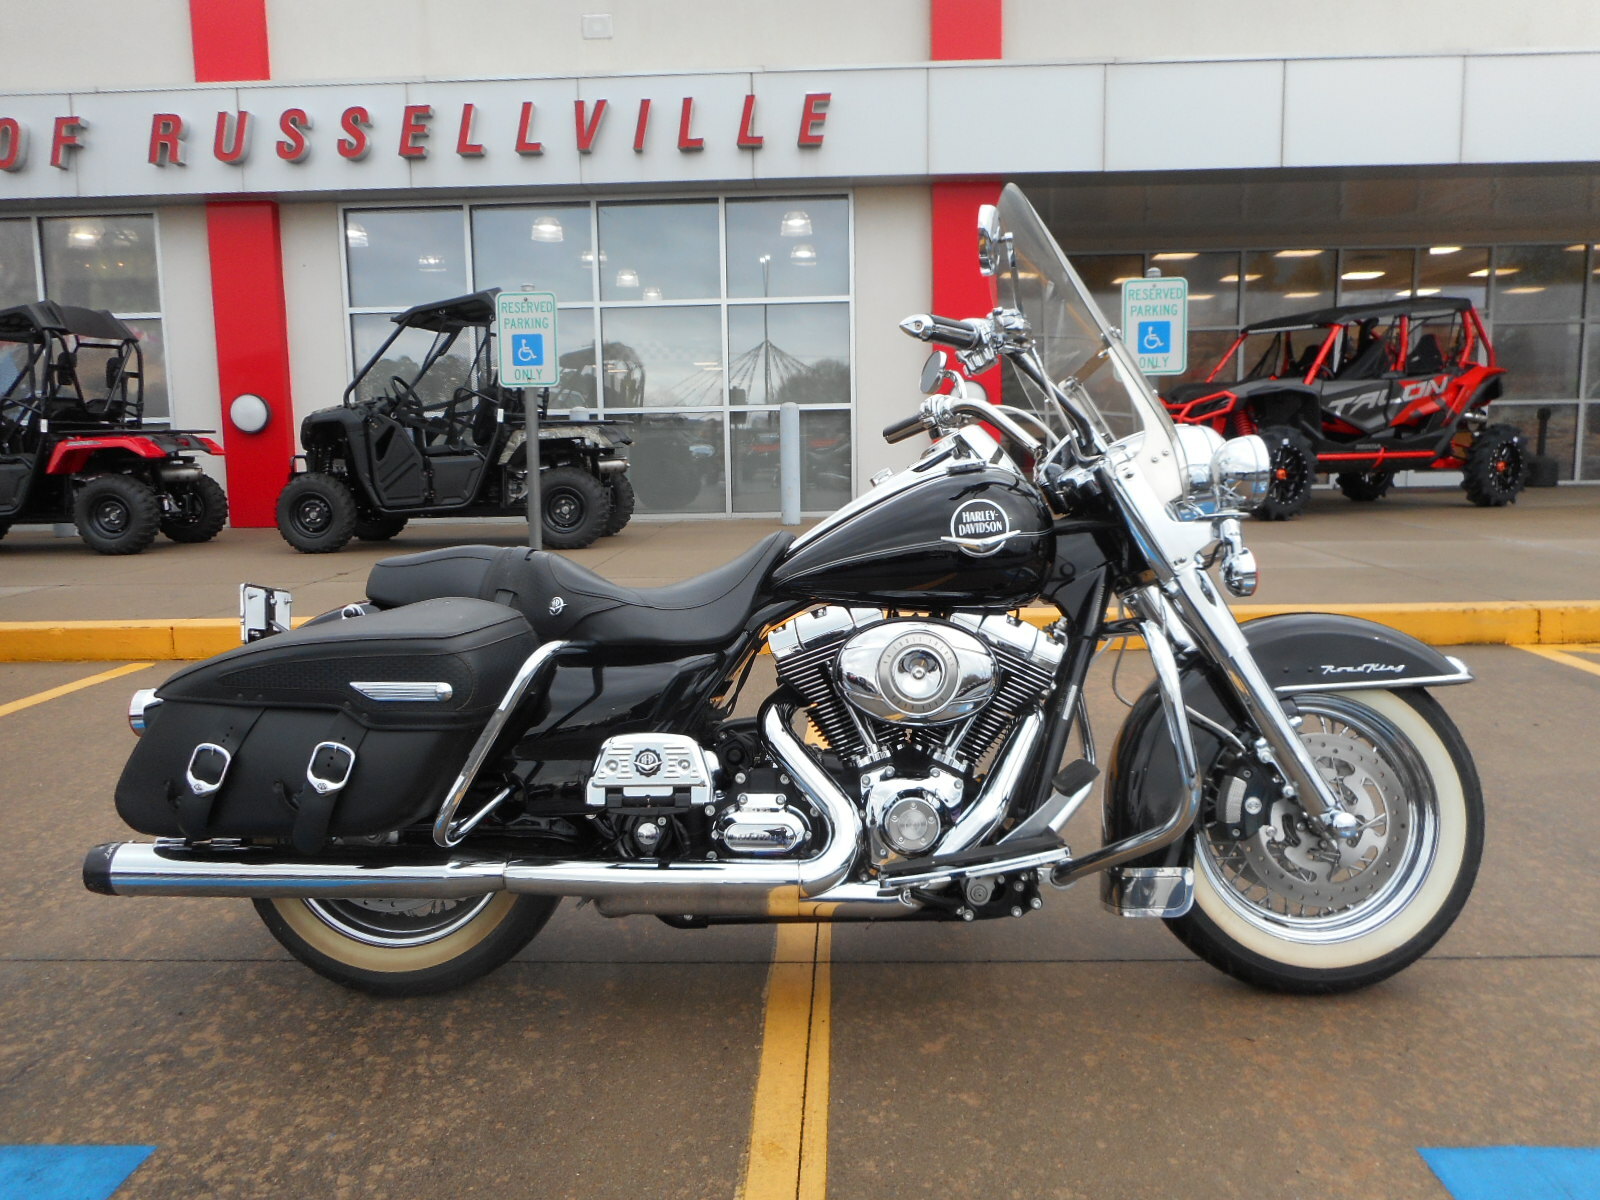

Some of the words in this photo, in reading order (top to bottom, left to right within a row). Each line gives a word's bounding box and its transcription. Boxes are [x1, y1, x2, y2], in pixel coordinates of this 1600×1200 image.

[0, 116, 86, 170] OF
[148, 92, 832, 168] RUSSELLVILLE
[1128, 287, 1183, 300] RESERVED
[501, 301, 552, 313] RESERVED
[1130, 304, 1177, 316] PARKING
[504, 317, 548, 329] PARKING
[1139, 356, 1169, 368] ONLY
[514, 369, 542, 380] ONLY
[1327, 376, 1448, 416] TALON
[962, 510, 999, 523] HARLEY-
[958, 521, 1003, 536] DAVIDSON
